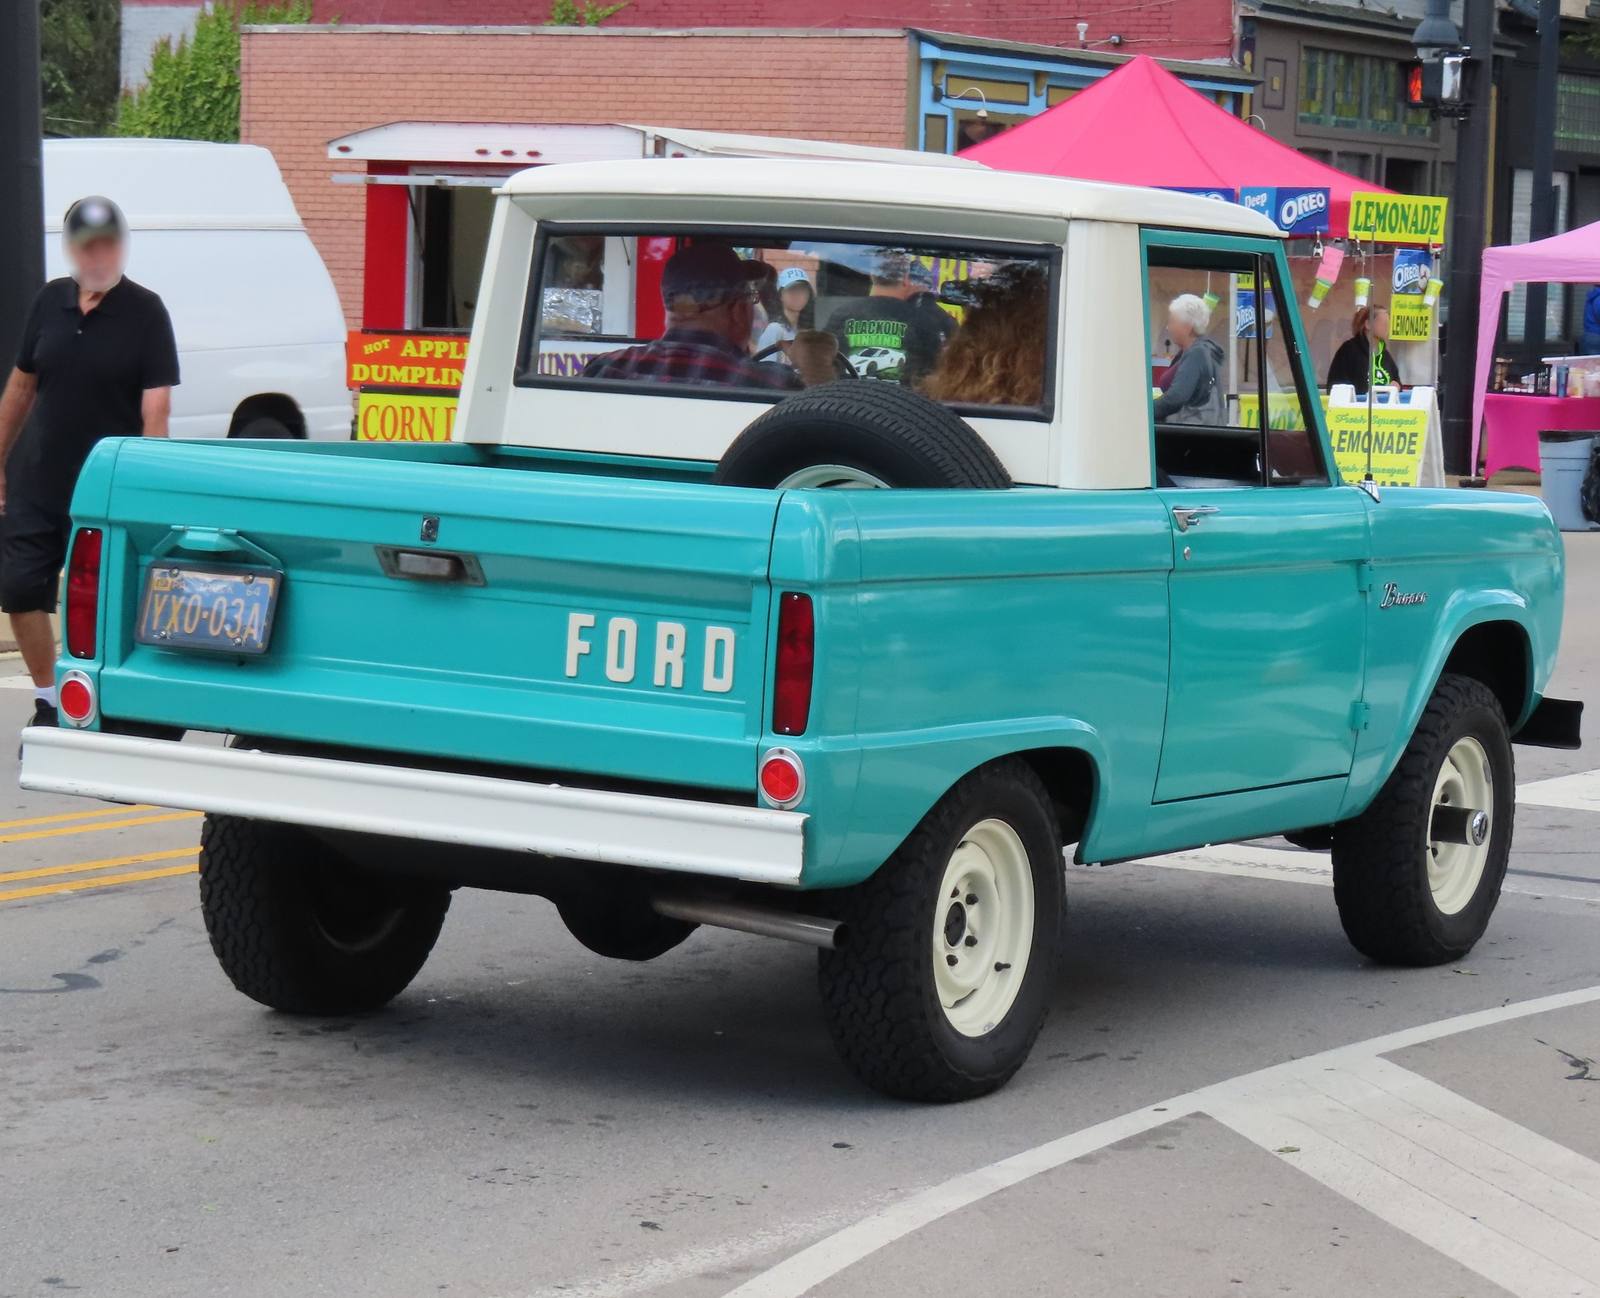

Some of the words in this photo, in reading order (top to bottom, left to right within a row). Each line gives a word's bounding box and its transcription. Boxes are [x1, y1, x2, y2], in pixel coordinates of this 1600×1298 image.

[1245, 192, 1267, 208] Deep
[1281, 191, 1326, 226] OREO
[1353, 200, 1441, 236] LEMONADE
[845, 318, 908, 337] BLACKOUT
[1391, 315, 1429, 337] LEMONADE
[363, 338, 391, 355] HOT
[848, 333, 903, 348] TINTING
[540, 353, 593, 376] UNN
[362, 404, 436, 441] CORN
[1335, 413, 1367, 424] Fresh
[1329, 429, 1419, 455] LEMONADE
[1337, 462, 1359, 473] resh
[565, 612, 735, 693] FORD
